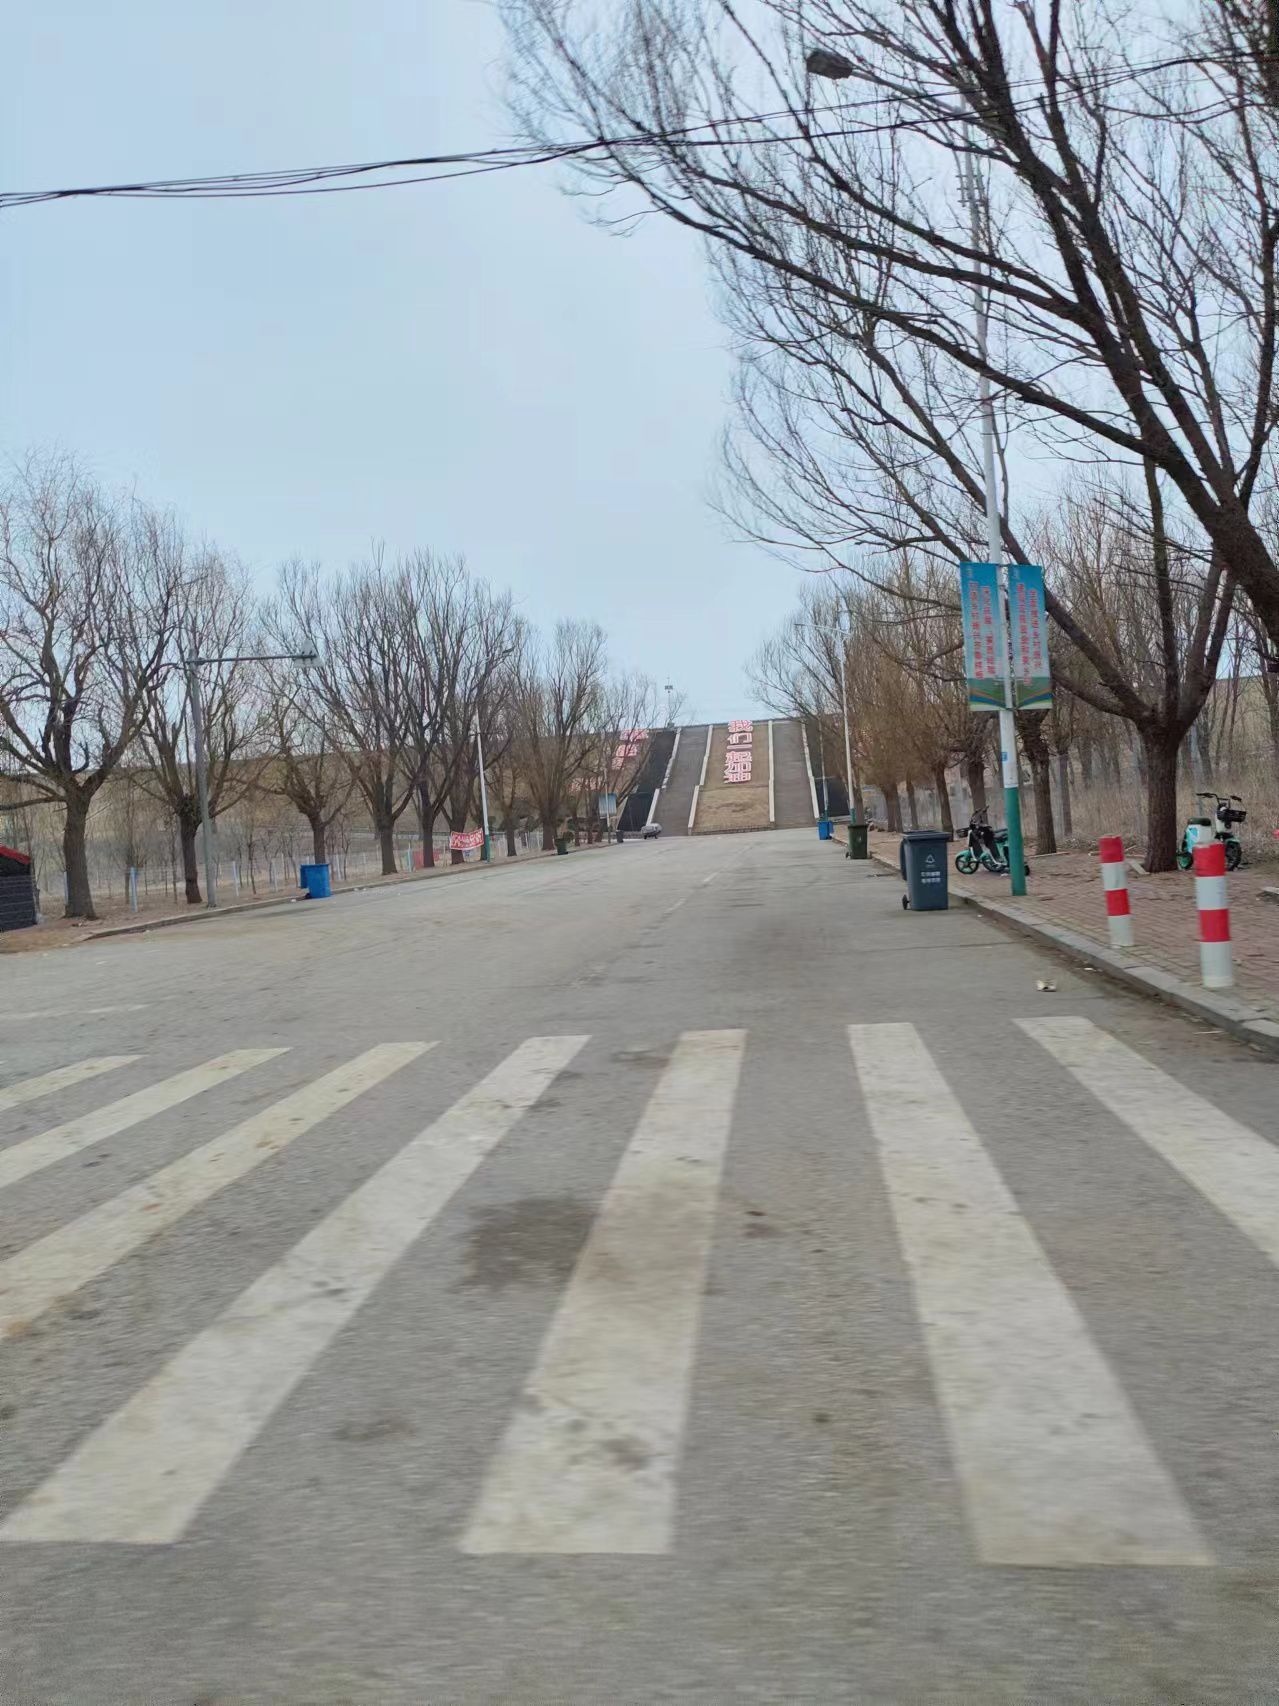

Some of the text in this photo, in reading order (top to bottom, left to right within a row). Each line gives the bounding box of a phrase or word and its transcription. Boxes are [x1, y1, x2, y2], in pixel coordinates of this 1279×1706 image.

[724, 720, 753, 784] 我们一起加油
